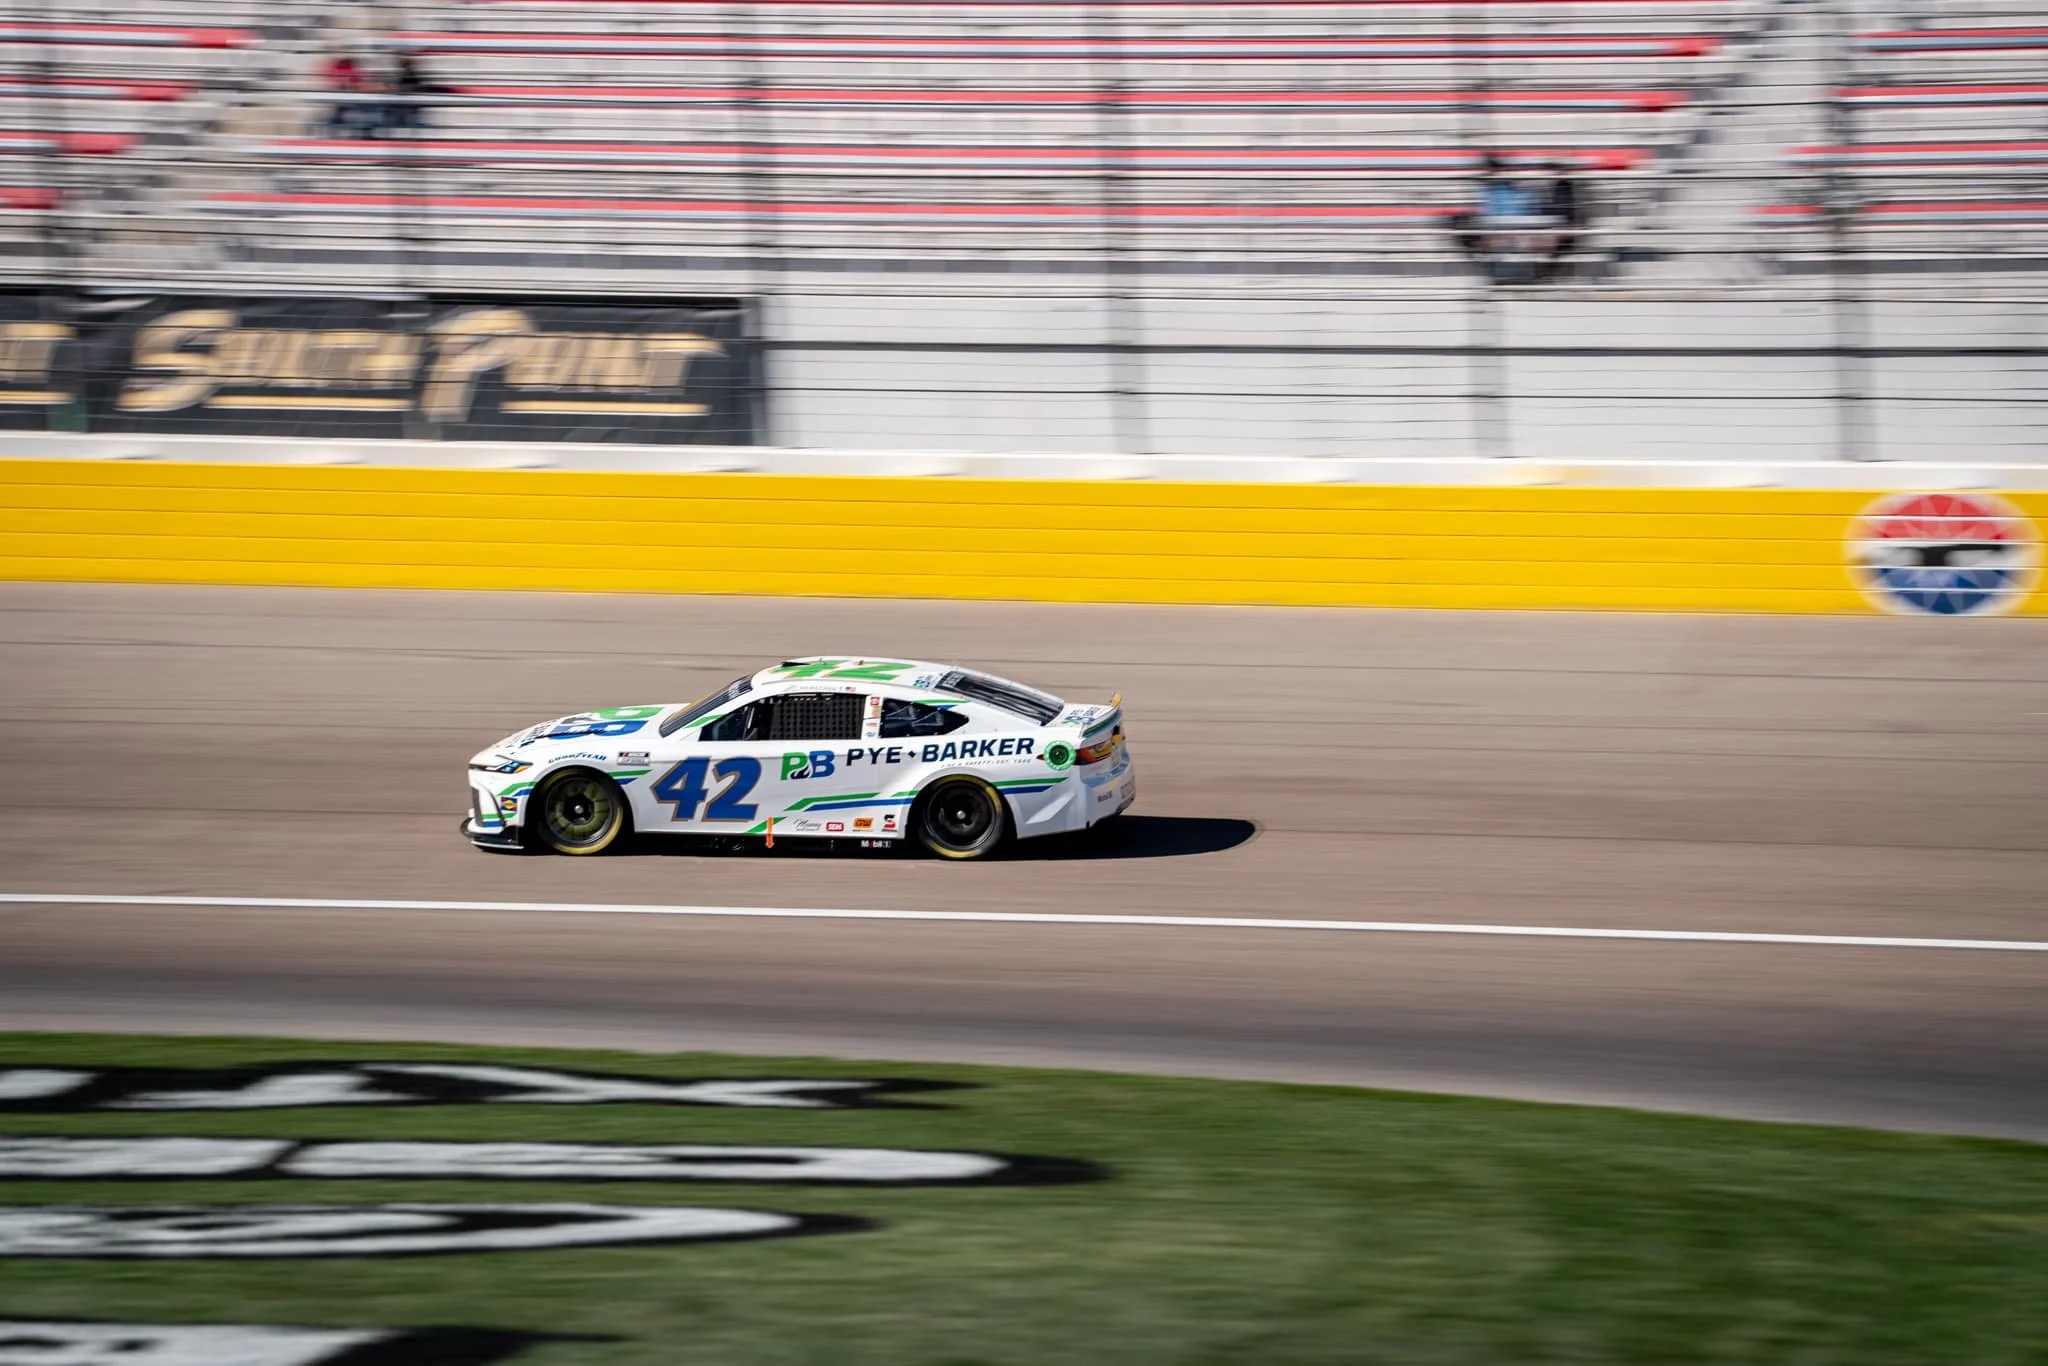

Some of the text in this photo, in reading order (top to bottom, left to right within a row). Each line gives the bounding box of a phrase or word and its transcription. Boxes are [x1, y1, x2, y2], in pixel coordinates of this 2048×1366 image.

[846, 738, 1035, 767] PYE BARKER
[650, 756, 762, 822] 42
